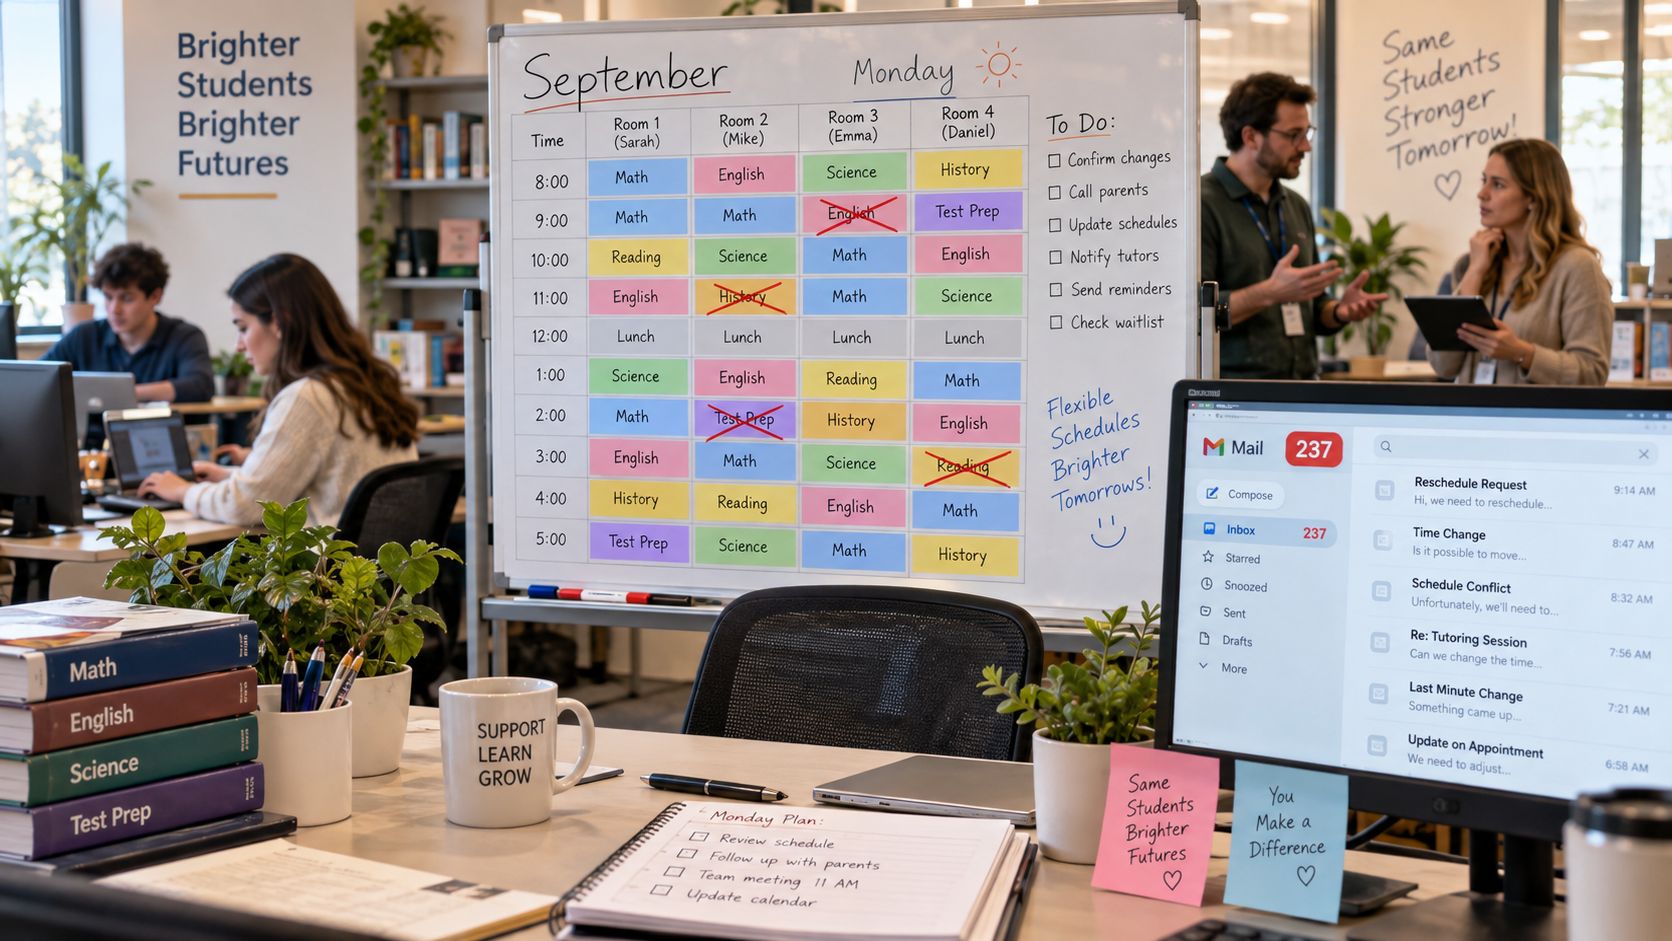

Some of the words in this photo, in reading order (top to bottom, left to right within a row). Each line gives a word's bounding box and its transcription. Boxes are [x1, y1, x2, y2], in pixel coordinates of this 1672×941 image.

[178, 32, 300, 64] Brighter
[1383, 30, 1454, 65] Same
[524, 52, 728, 112] September
[853, 55, 955, 95] Monday
[1383, 48, 1500, 101] Students
[178, 71, 312, 99] Students
[719, 115, 753, 127] Room
[758, 114, 769, 126] 2
[828, 110, 863, 124] Room
[868, 109, 879, 122] 3
[942, 107, 980, 120] Room
[984, 106, 994, 118] 4
[1384, 89, 1495, 137] Stronger
[178, 111, 300, 143] Brighter
[613, 117, 647, 130] Room
[653, 117, 660, 129] 1
[1046, 114, 1068, 135] To
[1079, 113, 1115, 133] Do:
[531, 133, 564, 147] Time
[722, 131, 765, 147] (Mike)
[828, 128, 879, 143] (Emma)
[942, 124, 996, 140] (Daniel)
[613, 134, 661, 150] (Sarah)
[1386, 113, 1517, 169] Tomorrow!
[178, 150, 289, 177] Futures
[1068, 151, 1115, 167] Confirm
[1121, 150, 1171, 169] changes
[615, 170, 649, 184] Math
[718, 167, 765, 183] English
[826, 165, 877, 179] Science
[941, 162, 990, 179] History
[535, 175, 569, 189] 8:00
[1069, 184, 1092, 199] Call
[1100, 183, 1149, 202] parents
[615, 210, 649, 224] Math
[723, 208, 757, 222] Math
[935, 204, 965, 218] Test
[969, 204, 1001, 220] Prep
[535, 213, 569, 228] 9:00
[1069, 216, 1113, 236] Update
[1119, 214, 1178, 230] schedules
[1071, 249, 1111, 268] Notify
[1117, 249, 1159, 263] tutors
[833, 289, 867, 303] Math
[942, 288, 992, 304] Science
[1072, 282, 1102, 296] Send
[1109, 281, 1172, 295] reminders
[532, 290, 569, 305] 11:00
[613, 290, 658, 306] English
[1071, 315, 1109, 329] Check
[1115, 314, 1164, 329] waitlist
[532, 329, 568, 344] 12:00
[617, 329, 655, 344] Lunch
[724, 330, 762, 345] Lunch
[833, 330, 872, 345] Lunch
[945, 331, 985, 346] Lunch
[536, 367, 565, 382] 1:00
[612, 369, 660, 383] Science
[719, 370, 766, 386] English
[826, 371, 877, 389] Reading
[945, 373, 980, 388] Math
[1047, 388, 1114, 419] Flexible
[535, 408, 566, 423] 2:00
[616, 409, 649, 423] Math
[827, 413, 875, 430] History
[940, 415, 988, 432] English
[1051, 412, 1140, 450] Schedules
[1231, 440, 1264, 456] Mail
[1296, 440, 1333, 459] 237
[535, 449, 567, 464] 3:00
[613, 450, 659, 466] English
[723, 454, 757, 468] Math
[826, 456, 876, 471] Science
[1051, 448, 1130, 482] Brighter
[1051, 466, 1151, 512] Tomorrows!
[1415, 476, 1479, 490] Reschedule
[1482, 478, 1527, 493] Request
[1614, 485, 1636, 496] 9:14
[1639, 486, 1656, 496] AM
[1228, 488, 1273, 503] Compose
[1227, 524, 1256, 537] Inbox
[1303, 527, 1327, 540] 237
[1414, 527, 1440, 540] Time
[1443, 528, 1486, 543] Change
[535, 531, 567, 547] 5:00
[609, 534, 636, 548] Test
[641, 535, 668, 553] Prep
[719, 538, 768, 554] Science
[1612, 538, 1634, 549] 8:47
[1638, 539, 1655, 550] AM
[833, 543, 867, 558] Math
[938, 547, 987, 565] History
[1226, 552, 1261, 565] Starred
[1412, 546, 1422, 557] Is
[1424, 546, 1431, 558] it
[1434, 547, 1474, 561] possible
[1476, 549, 1486, 560] to
[1224, 580, 1268, 593] Snoozed
[1412, 578, 1463, 592] Schedule
[1466, 580, 1511, 595] Conflict
[1224, 607, 1246, 620] Sent
[1223, 634, 1253, 647] Drafts
[1410, 630, 1428, 642] Re:
[1432, 631, 1479, 648] Tutoring
[1483, 635, 1528, 650] Session
[69, 657, 117, 684] Math
[1222, 662, 1248, 675] More
[1410, 682, 1432, 695] Last
[1436, 684, 1474, 698] Minute
[1478, 687, 1523, 703] Change
[1409, 700, 1464, 717] Something
[1467, 706, 1496, 719] came
[70, 704, 135, 737] English
[477, 718, 547, 739] SUPPORT
[478, 744, 533, 763] LEARN
[1408, 733, 1448, 751] Update
[1451, 739, 1466, 750] on
[1469, 740, 1544, 760] Appointment
[1408, 752, 1424, 765] We
[1428, 755, 1451, 768] need
[1455, 758, 1466, 769] to
[70, 755, 140, 785] Science
[478, 767, 533, 786] GROW
[1128, 773, 1171, 793] Same
[1269, 786, 1294, 806] You
[1127, 797, 1194, 817] Students
[70, 813, 108, 837] Test
[113, 804, 152, 830] Prep
[710, 811, 774, 828] Monday
[783, 814, 824, 825] Plan:
[1256, 814, 1295, 831] Make
[1302, 817, 1311, 828] a
[720, 834, 767, 845] Review
[775, 838, 834, 849] schedule
[1126, 822, 1190, 845] Brighter
[1250, 839, 1326, 858] Difference
[709, 852, 753, 863] Follow
[761, 857, 779, 867] up
[786, 857, 816, 867] with
[824, 860, 880, 871] parents
[1128, 849, 1186, 865] Futures
[700, 870, 735, 881] Team
[744, 876, 801, 890] meeting
[815, 878, 826, 887] 11
[834, 878, 859, 889] AM
[687, 889, 742, 902] Update
[751, 895, 818, 908] calendar
